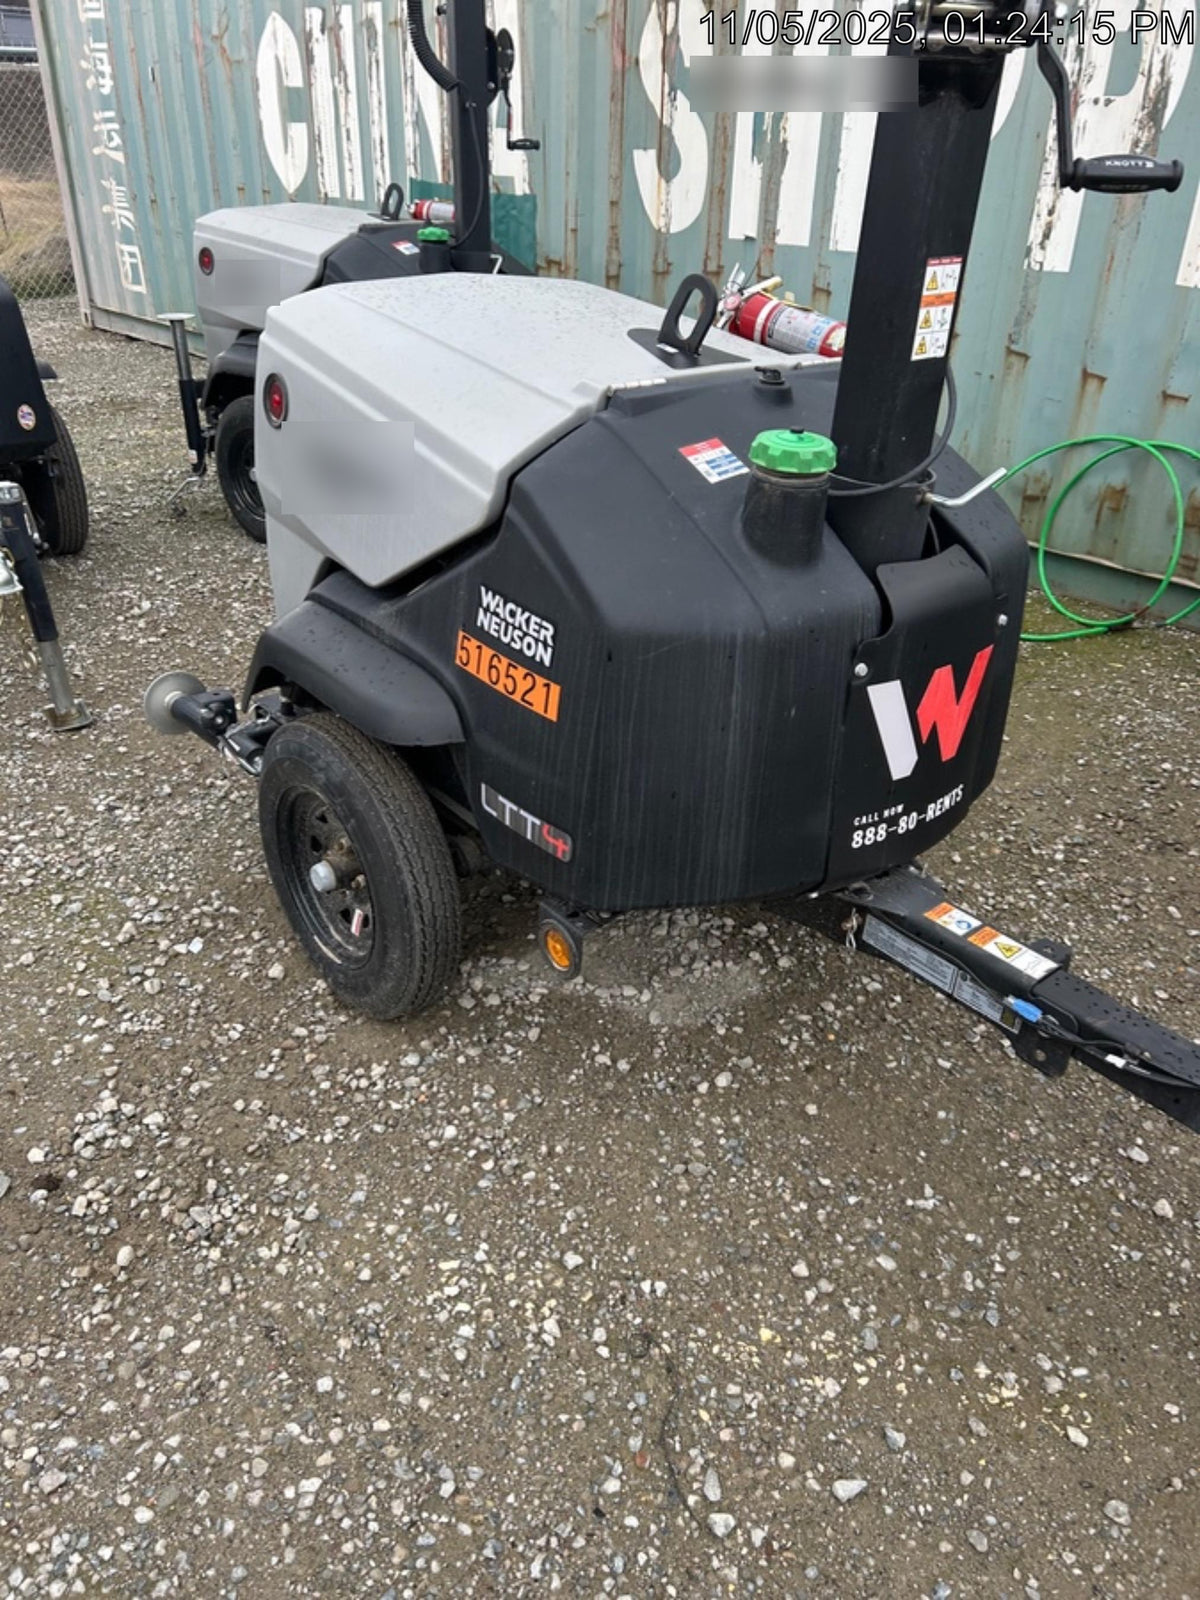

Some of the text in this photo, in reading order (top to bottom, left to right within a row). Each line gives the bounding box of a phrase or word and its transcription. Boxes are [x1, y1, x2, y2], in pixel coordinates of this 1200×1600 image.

[476, 607, 553, 668] NEUSON
[480, 585, 555, 646] WACKER
[458, 634, 551, 715] 516521
[481, 782, 570, 860] LTT4
[851, 783, 965, 849] 888-80-RENTS
[853, 811, 879, 826] CALL
